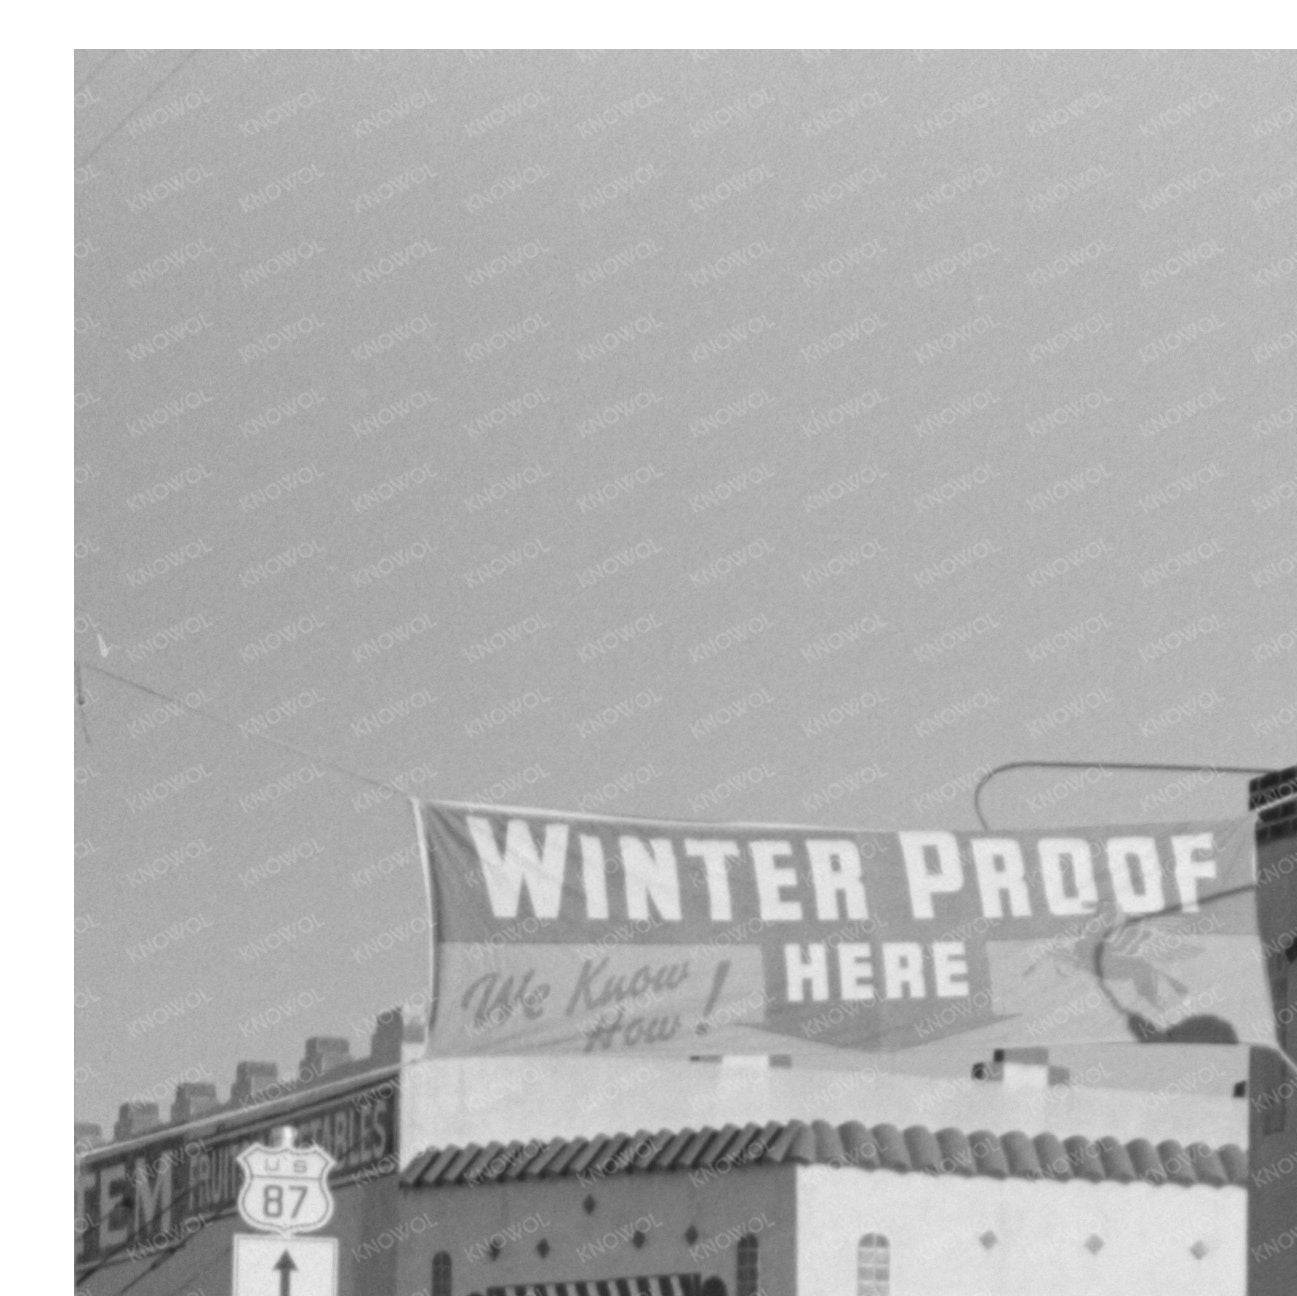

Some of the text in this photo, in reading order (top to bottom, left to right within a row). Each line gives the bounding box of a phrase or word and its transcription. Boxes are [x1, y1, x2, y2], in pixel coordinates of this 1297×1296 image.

[465, 815, 1217, 921] WINTER PROOF
[461, 957, 690, 1029] We Know
[784, 941, 969, 1001] HERE
[262, 1184, 309, 1219] 87
